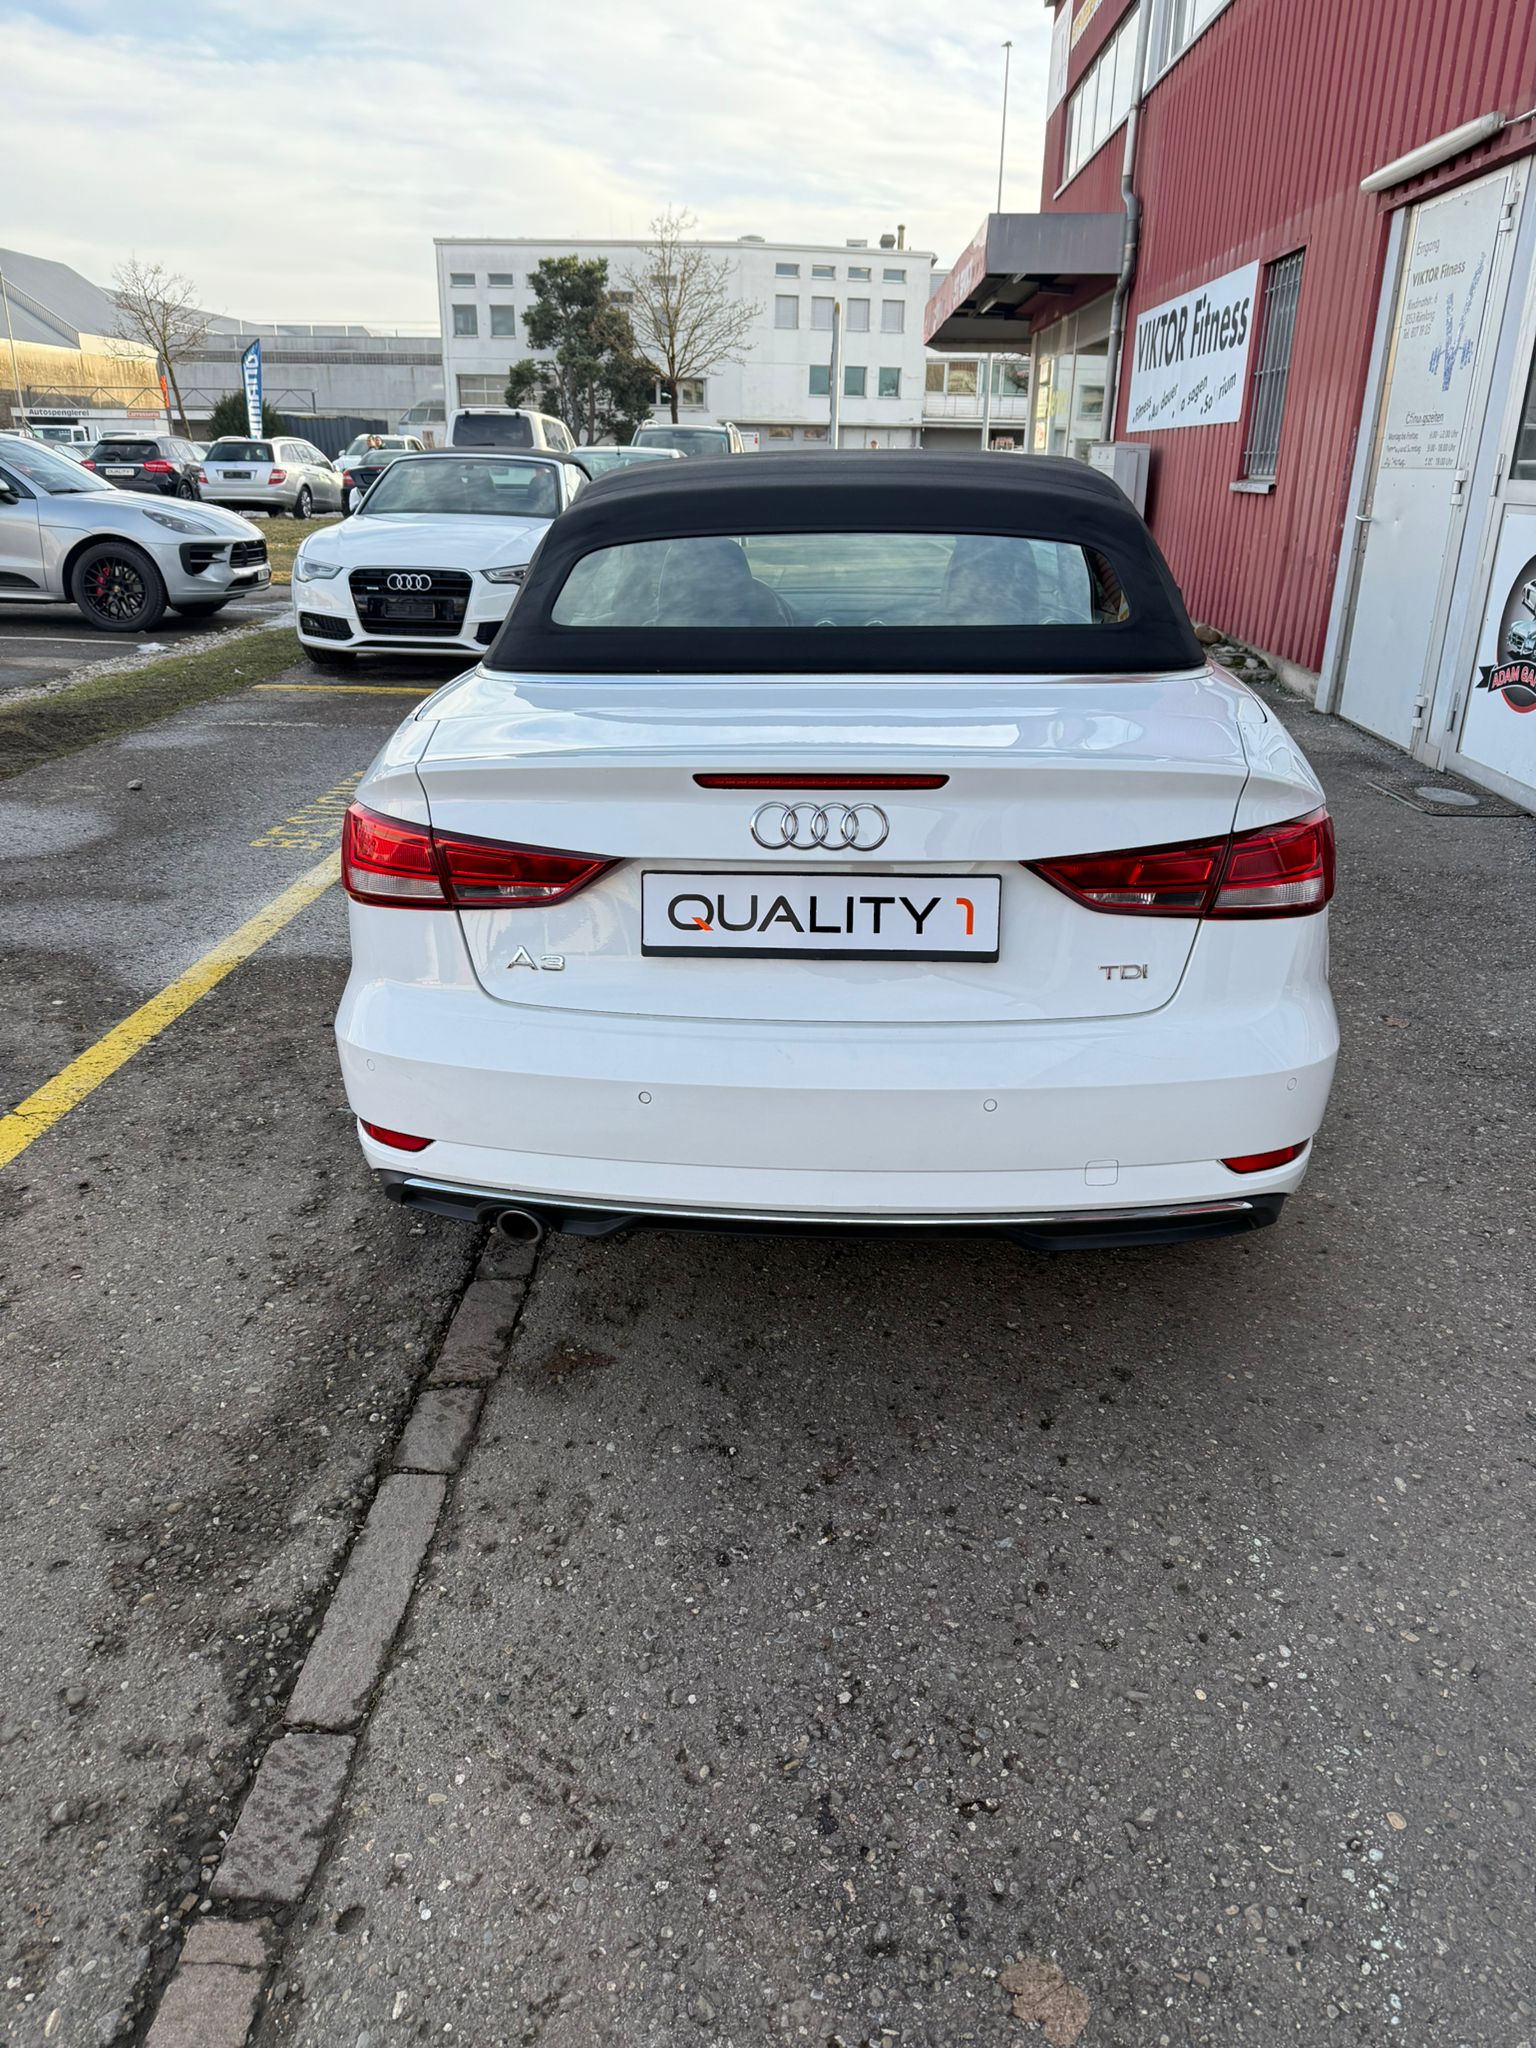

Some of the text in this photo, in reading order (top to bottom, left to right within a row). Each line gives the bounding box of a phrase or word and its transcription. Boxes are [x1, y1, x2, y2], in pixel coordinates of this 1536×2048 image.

[1416, 240, 1440, 257] Eingang
[1412, 261, 1466, 287] VIKTOR Fitness
[1138, 293, 1250, 373] VIKTOR Fitness
[1151, 383, 1179, 418] Audauer
[1204, 372, 1237, 414] Sorium
[29, 409, 90, 417] Autospenglerei
[1405, 410, 1445, 426] Öffnugszeiten
[1491, 665, 1520, 689] ADAM
[667, 893, 975, 935] QUALITY 1
[506, 944, 566, 971] A3
[1098, 964, 1148, 980] TDI
